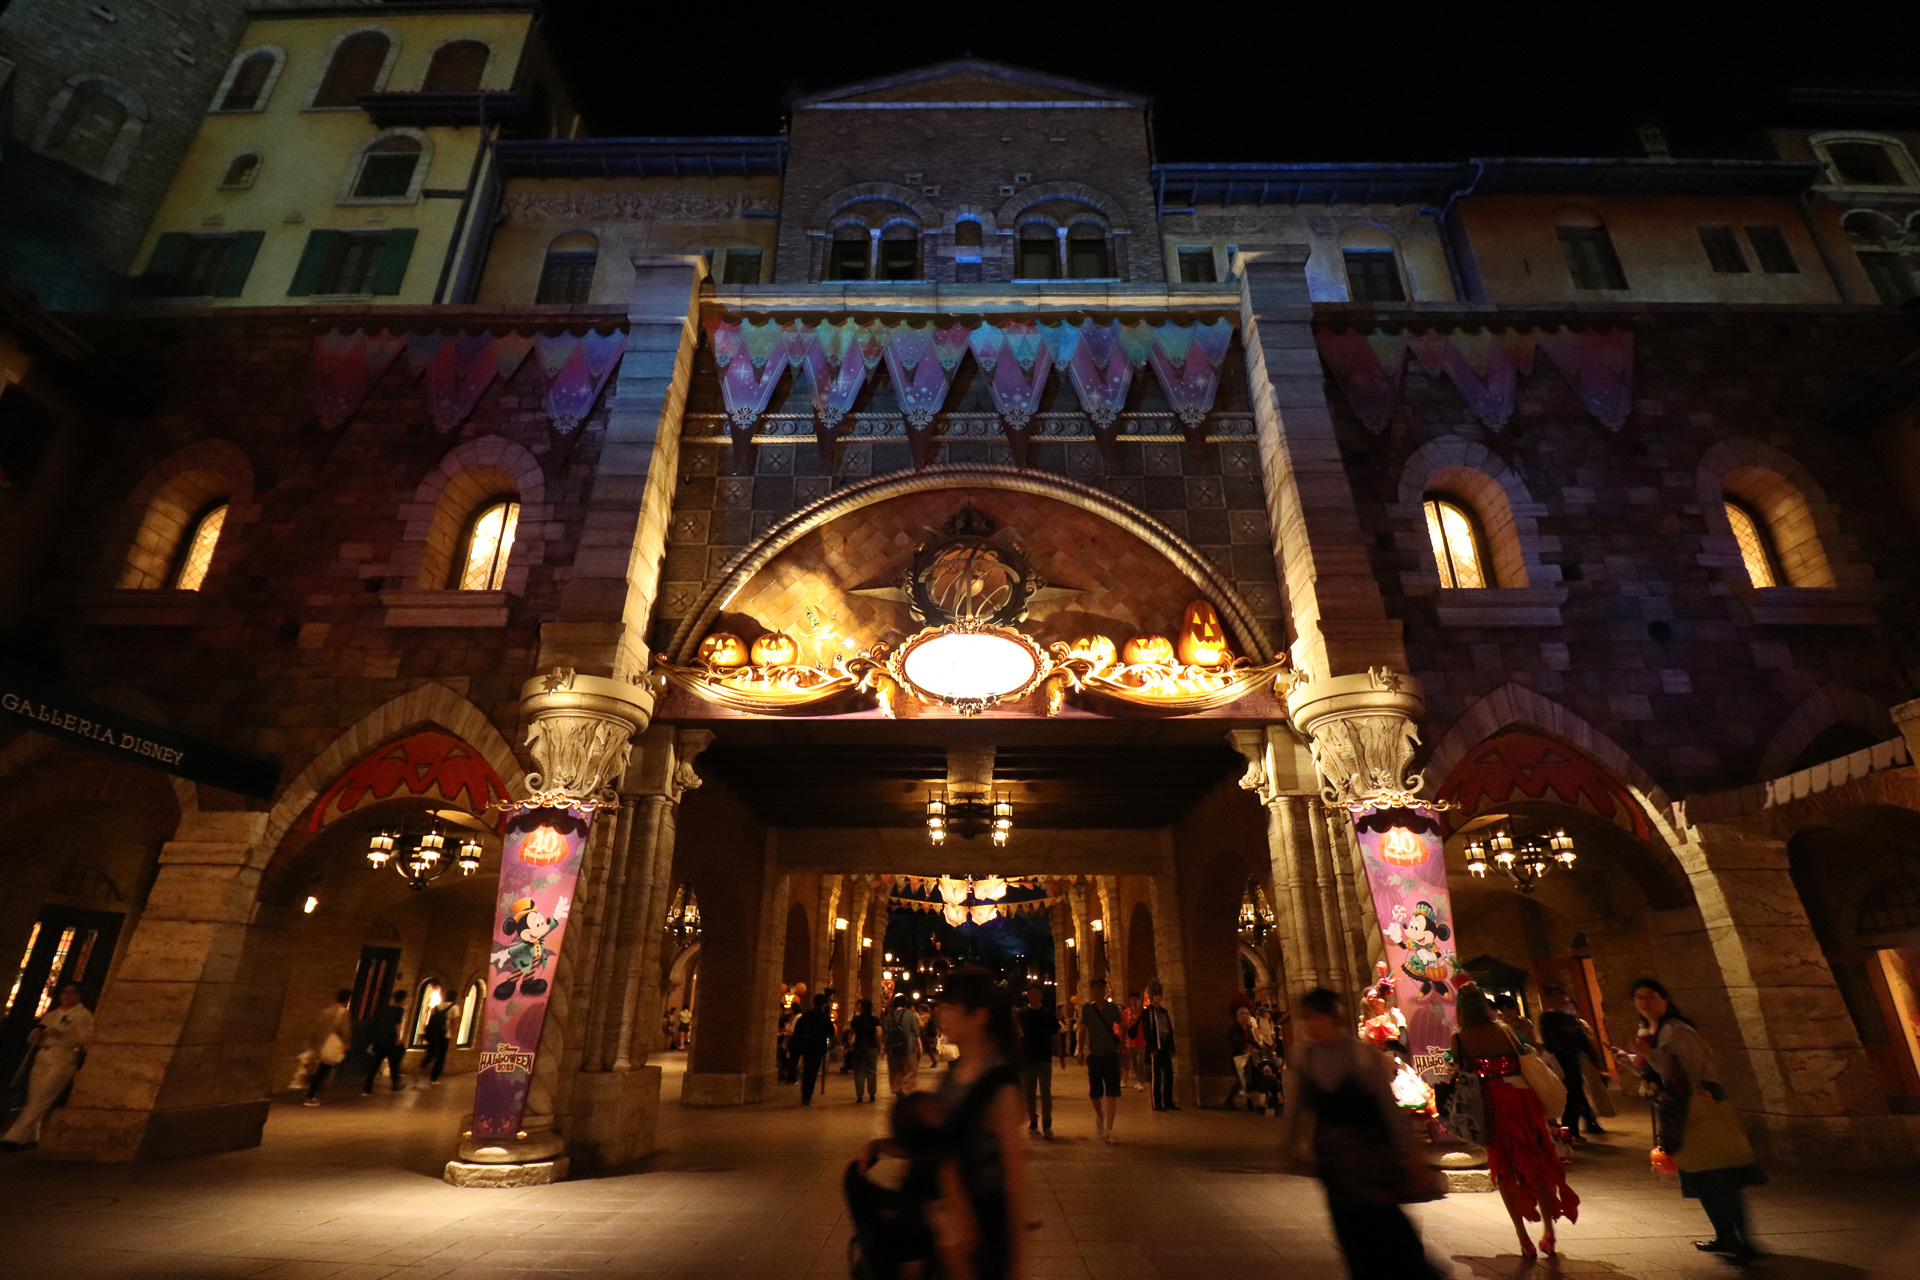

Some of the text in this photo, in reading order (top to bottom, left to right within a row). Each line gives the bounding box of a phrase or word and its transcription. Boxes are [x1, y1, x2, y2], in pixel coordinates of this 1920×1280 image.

[1, 693, 184, 766] GALLERIA DISNEY
[528, 829, 558, 853] 40
[1386, 830, 1415, 854] 40
[498, 1043, 519, 1054] Disney
[480, 1052, 534, 1073] HALLOWEEN
[496, 1063, 514, 1071] 2023
